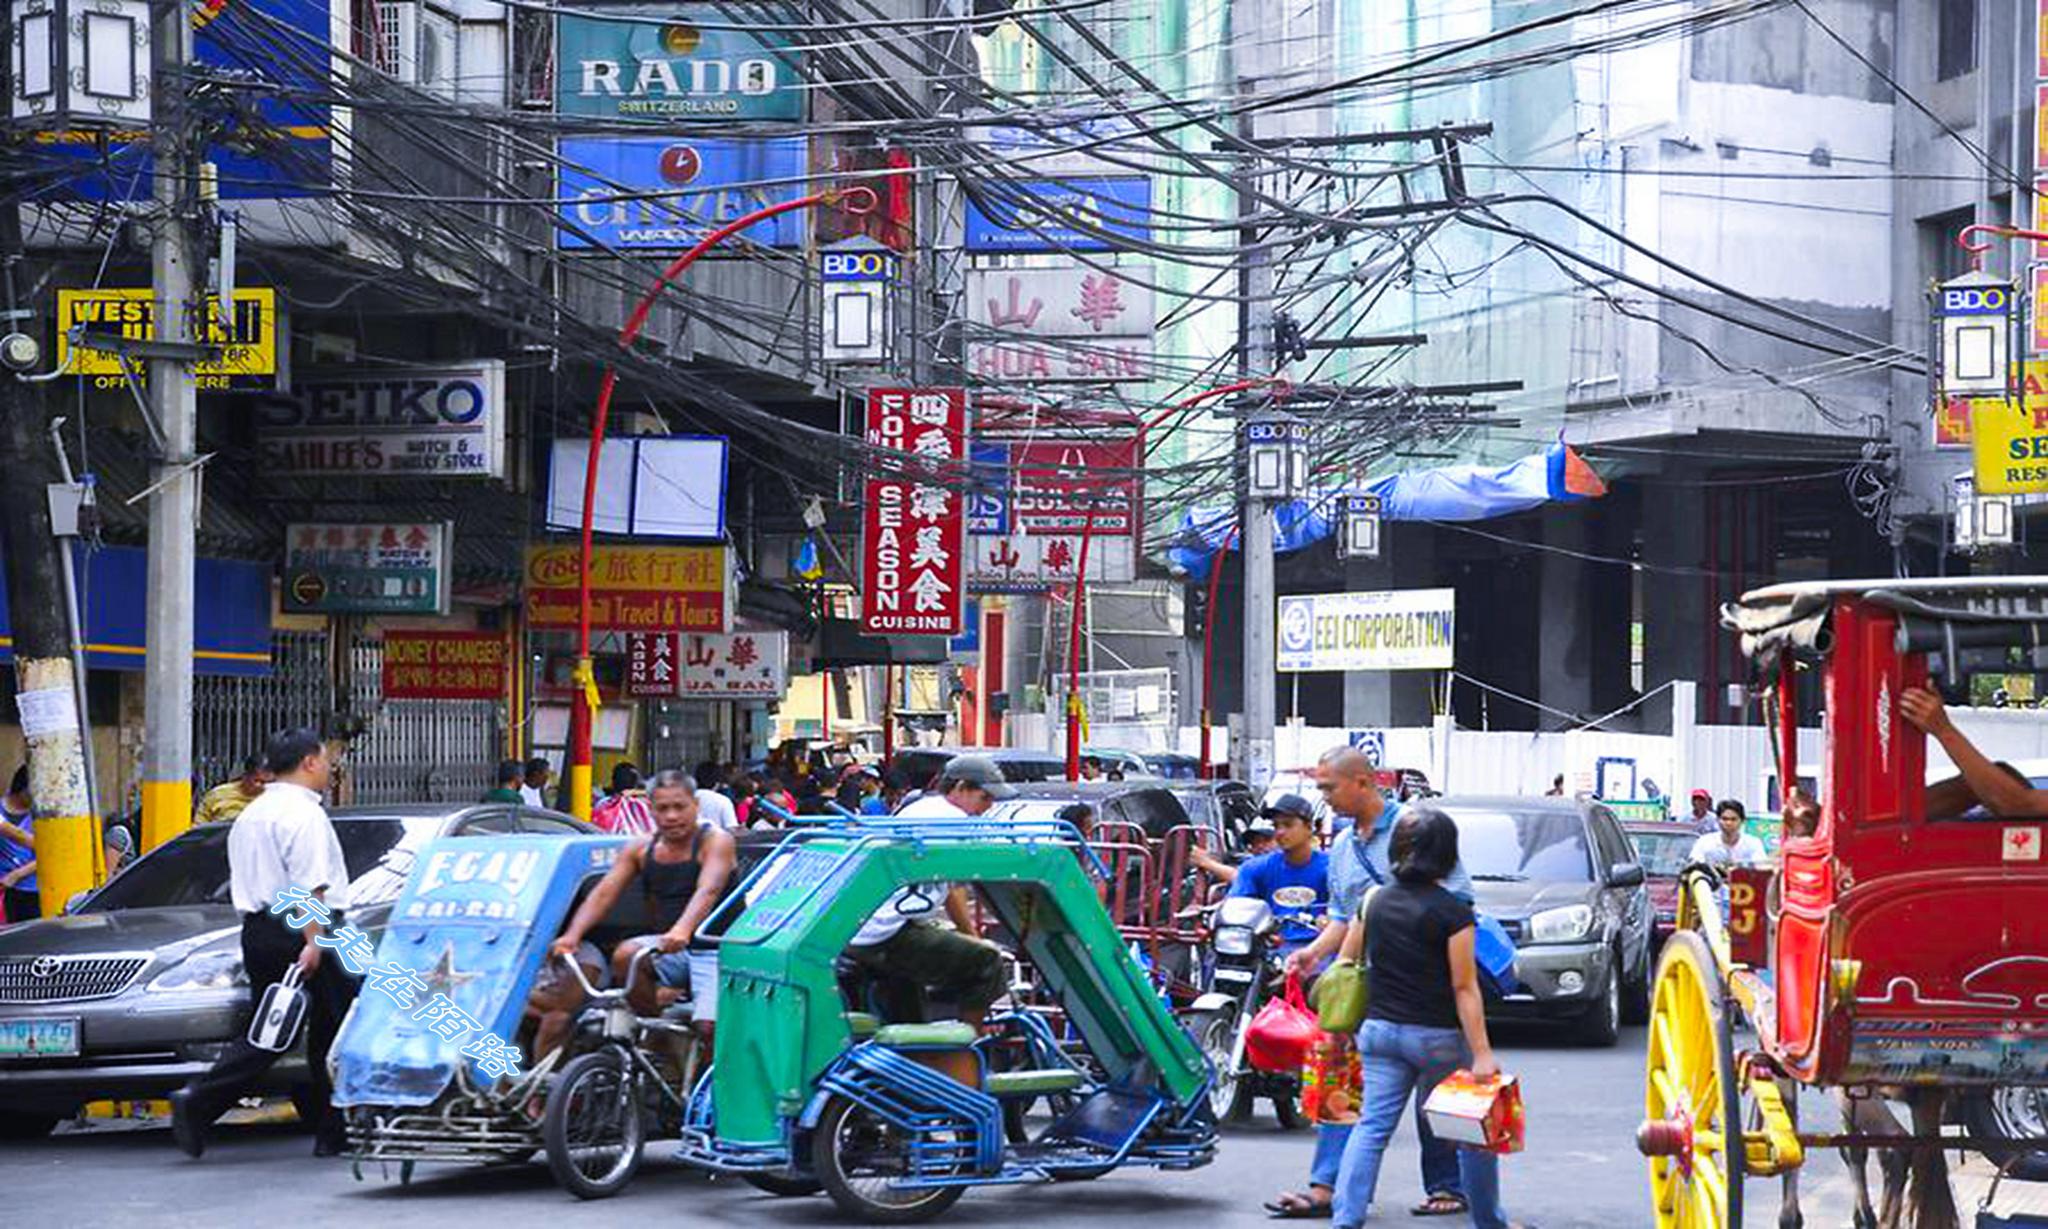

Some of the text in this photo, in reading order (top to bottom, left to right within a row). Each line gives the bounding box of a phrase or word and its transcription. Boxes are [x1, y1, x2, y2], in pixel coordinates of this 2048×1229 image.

[578, 59, 776, 96] RADO
[618, 100, 738, 114] SWITZERLAND
[824, 253, 882, 275] BDO
[1944, 289, 2005, 309] BDO
[253, 379, 484, 427] SEIKO
[444, 454, 484, 468] STORE
[877, 485, 903, 611] SEASON
[606, 552, 718, 584] 旅行社
[615, 597, 660, 625] Travel
[663, 597, 676, 625] &
[680, 597, 719, 626] Tours
[869, 615, 951, 630] CUISINE
[1343, 609, 1452, 650] CORPORATION
